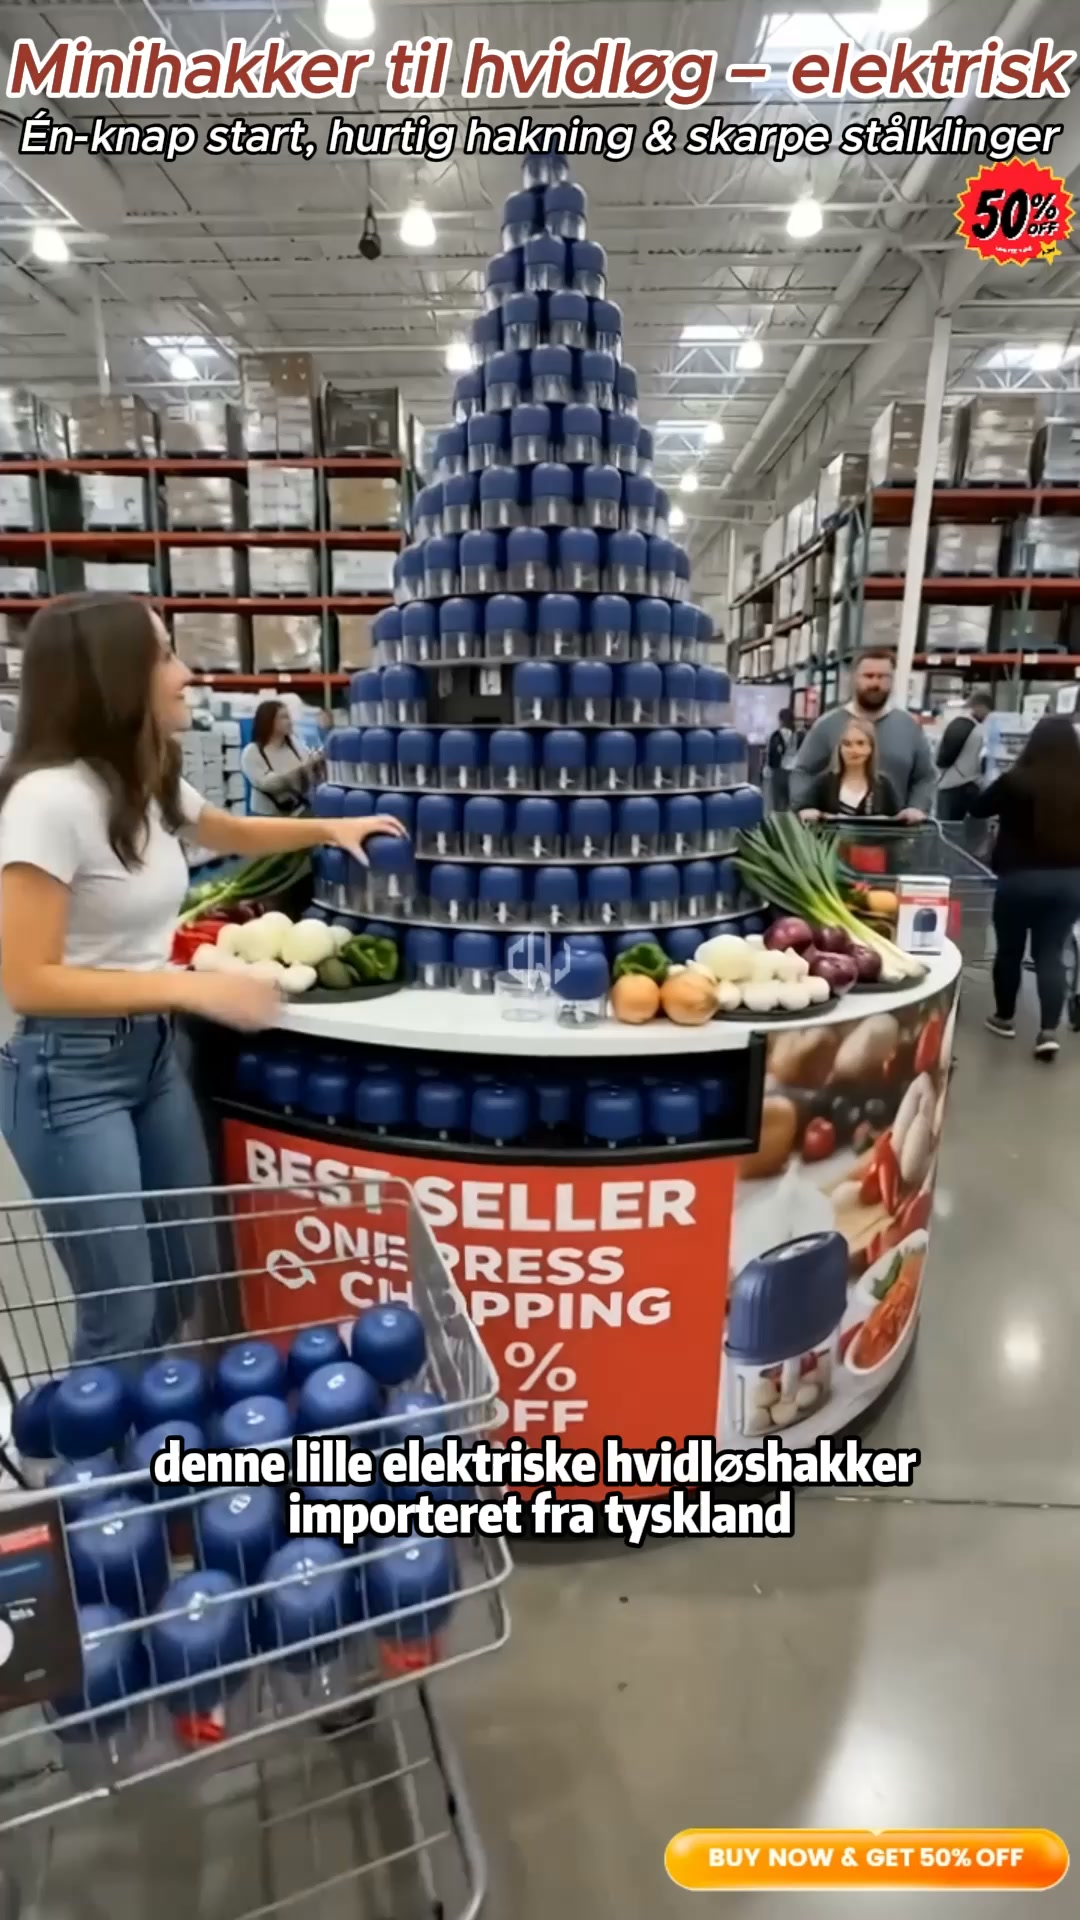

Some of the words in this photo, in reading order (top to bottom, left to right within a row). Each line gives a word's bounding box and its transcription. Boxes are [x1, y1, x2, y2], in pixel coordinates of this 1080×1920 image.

[246, 1139, 391, 1214] BEST
[412, 1175, 697, 1232] SELLER
[295, 1215, 408, 1272] ONE
[340, 1271, 672, 1329] CHPPING
